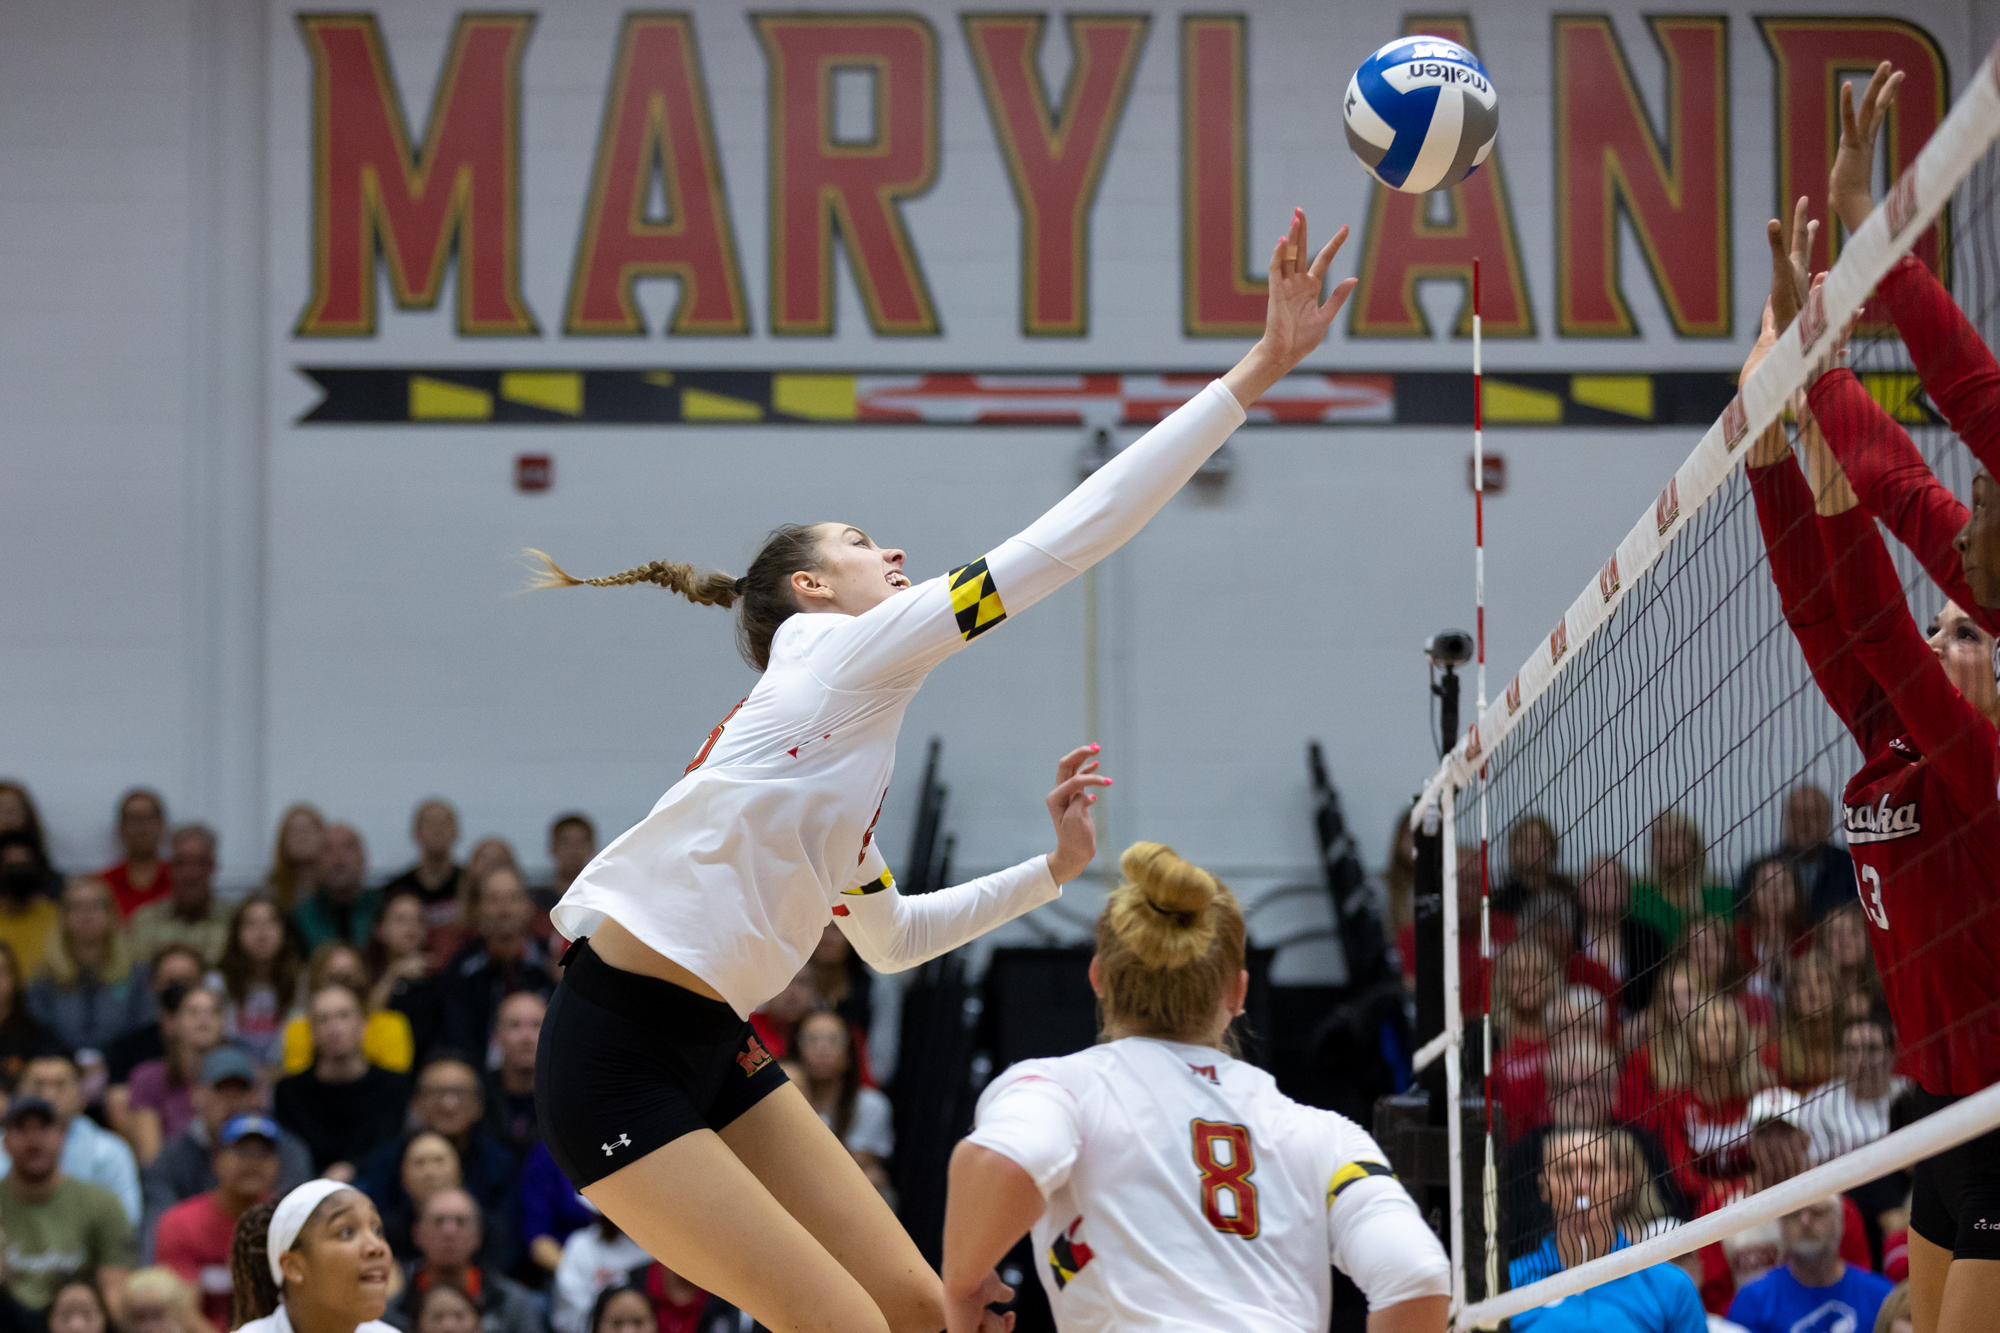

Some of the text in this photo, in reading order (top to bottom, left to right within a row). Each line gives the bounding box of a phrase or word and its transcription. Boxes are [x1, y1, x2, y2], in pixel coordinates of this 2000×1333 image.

[1409, 62, 1488, 94] molten
[294, 11, 1953, 337] MARYLAND
[1853, 859, 1890, 931] 3
[1190, 1117, 1260, 1241] 8
